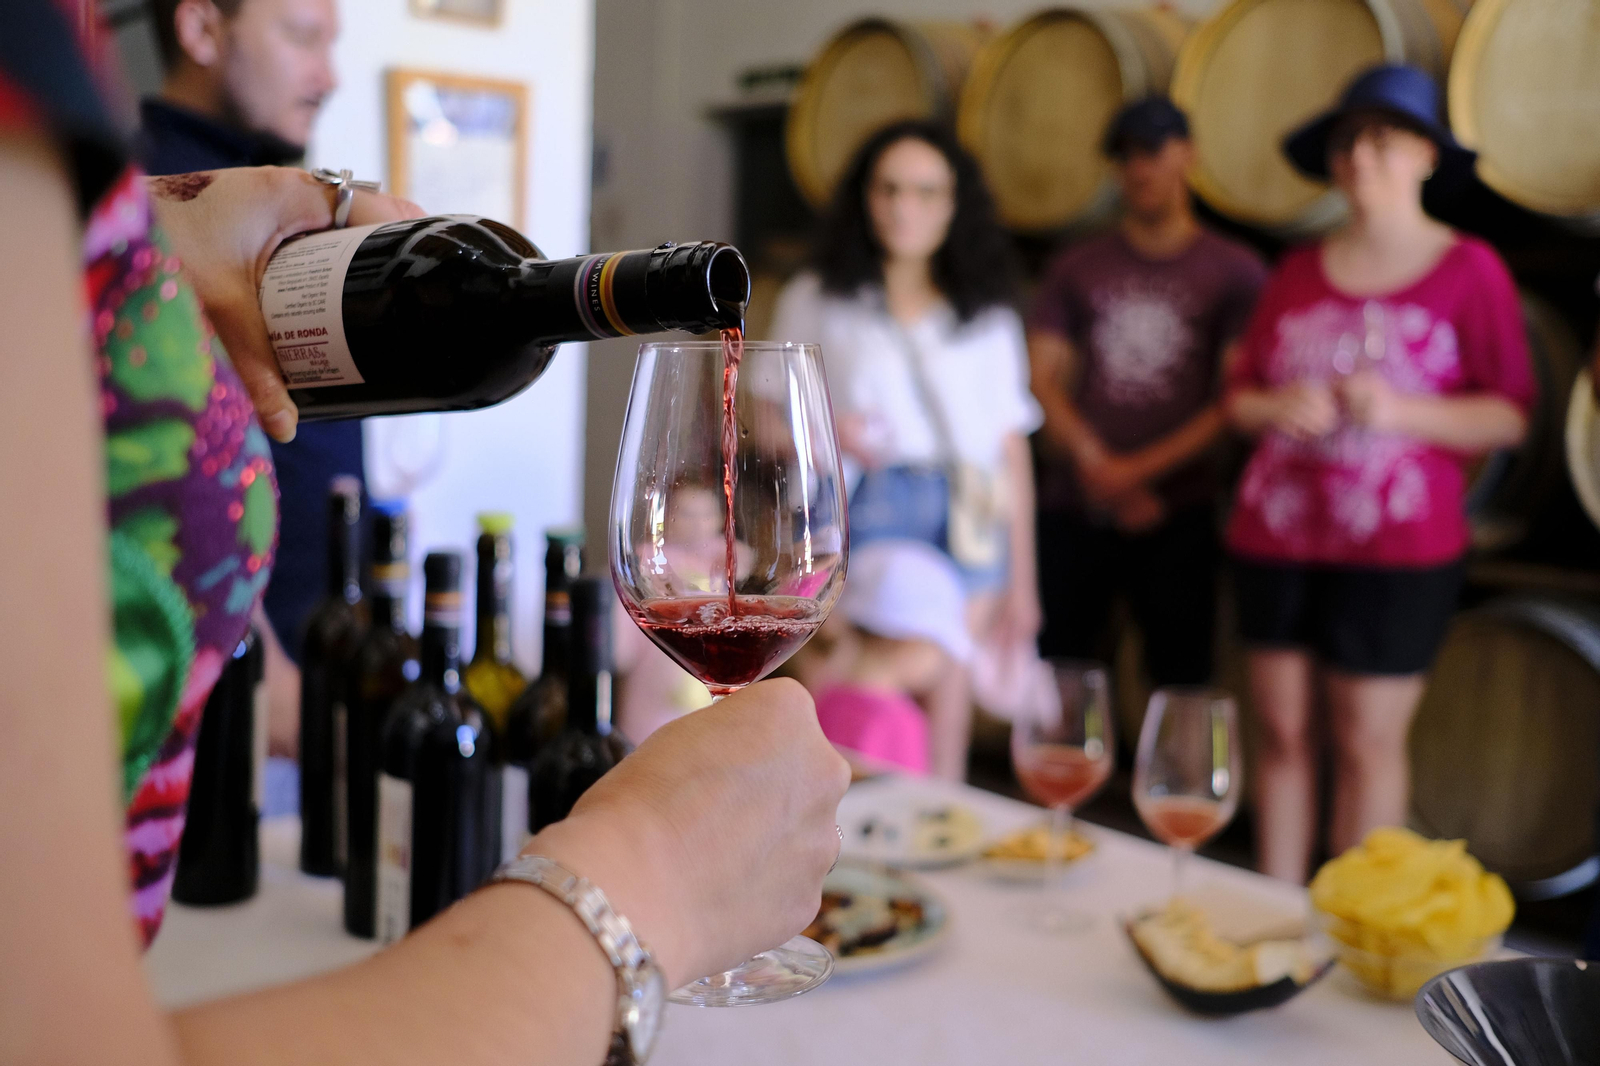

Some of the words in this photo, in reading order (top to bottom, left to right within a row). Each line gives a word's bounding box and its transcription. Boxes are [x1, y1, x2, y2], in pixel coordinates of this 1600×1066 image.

[591, 272, 600, 311] WINES
[284, 330, 295, 340] DE
[297, 327, 328, 338] RONDA
[278, 347, 320, 361] SIERRAS
